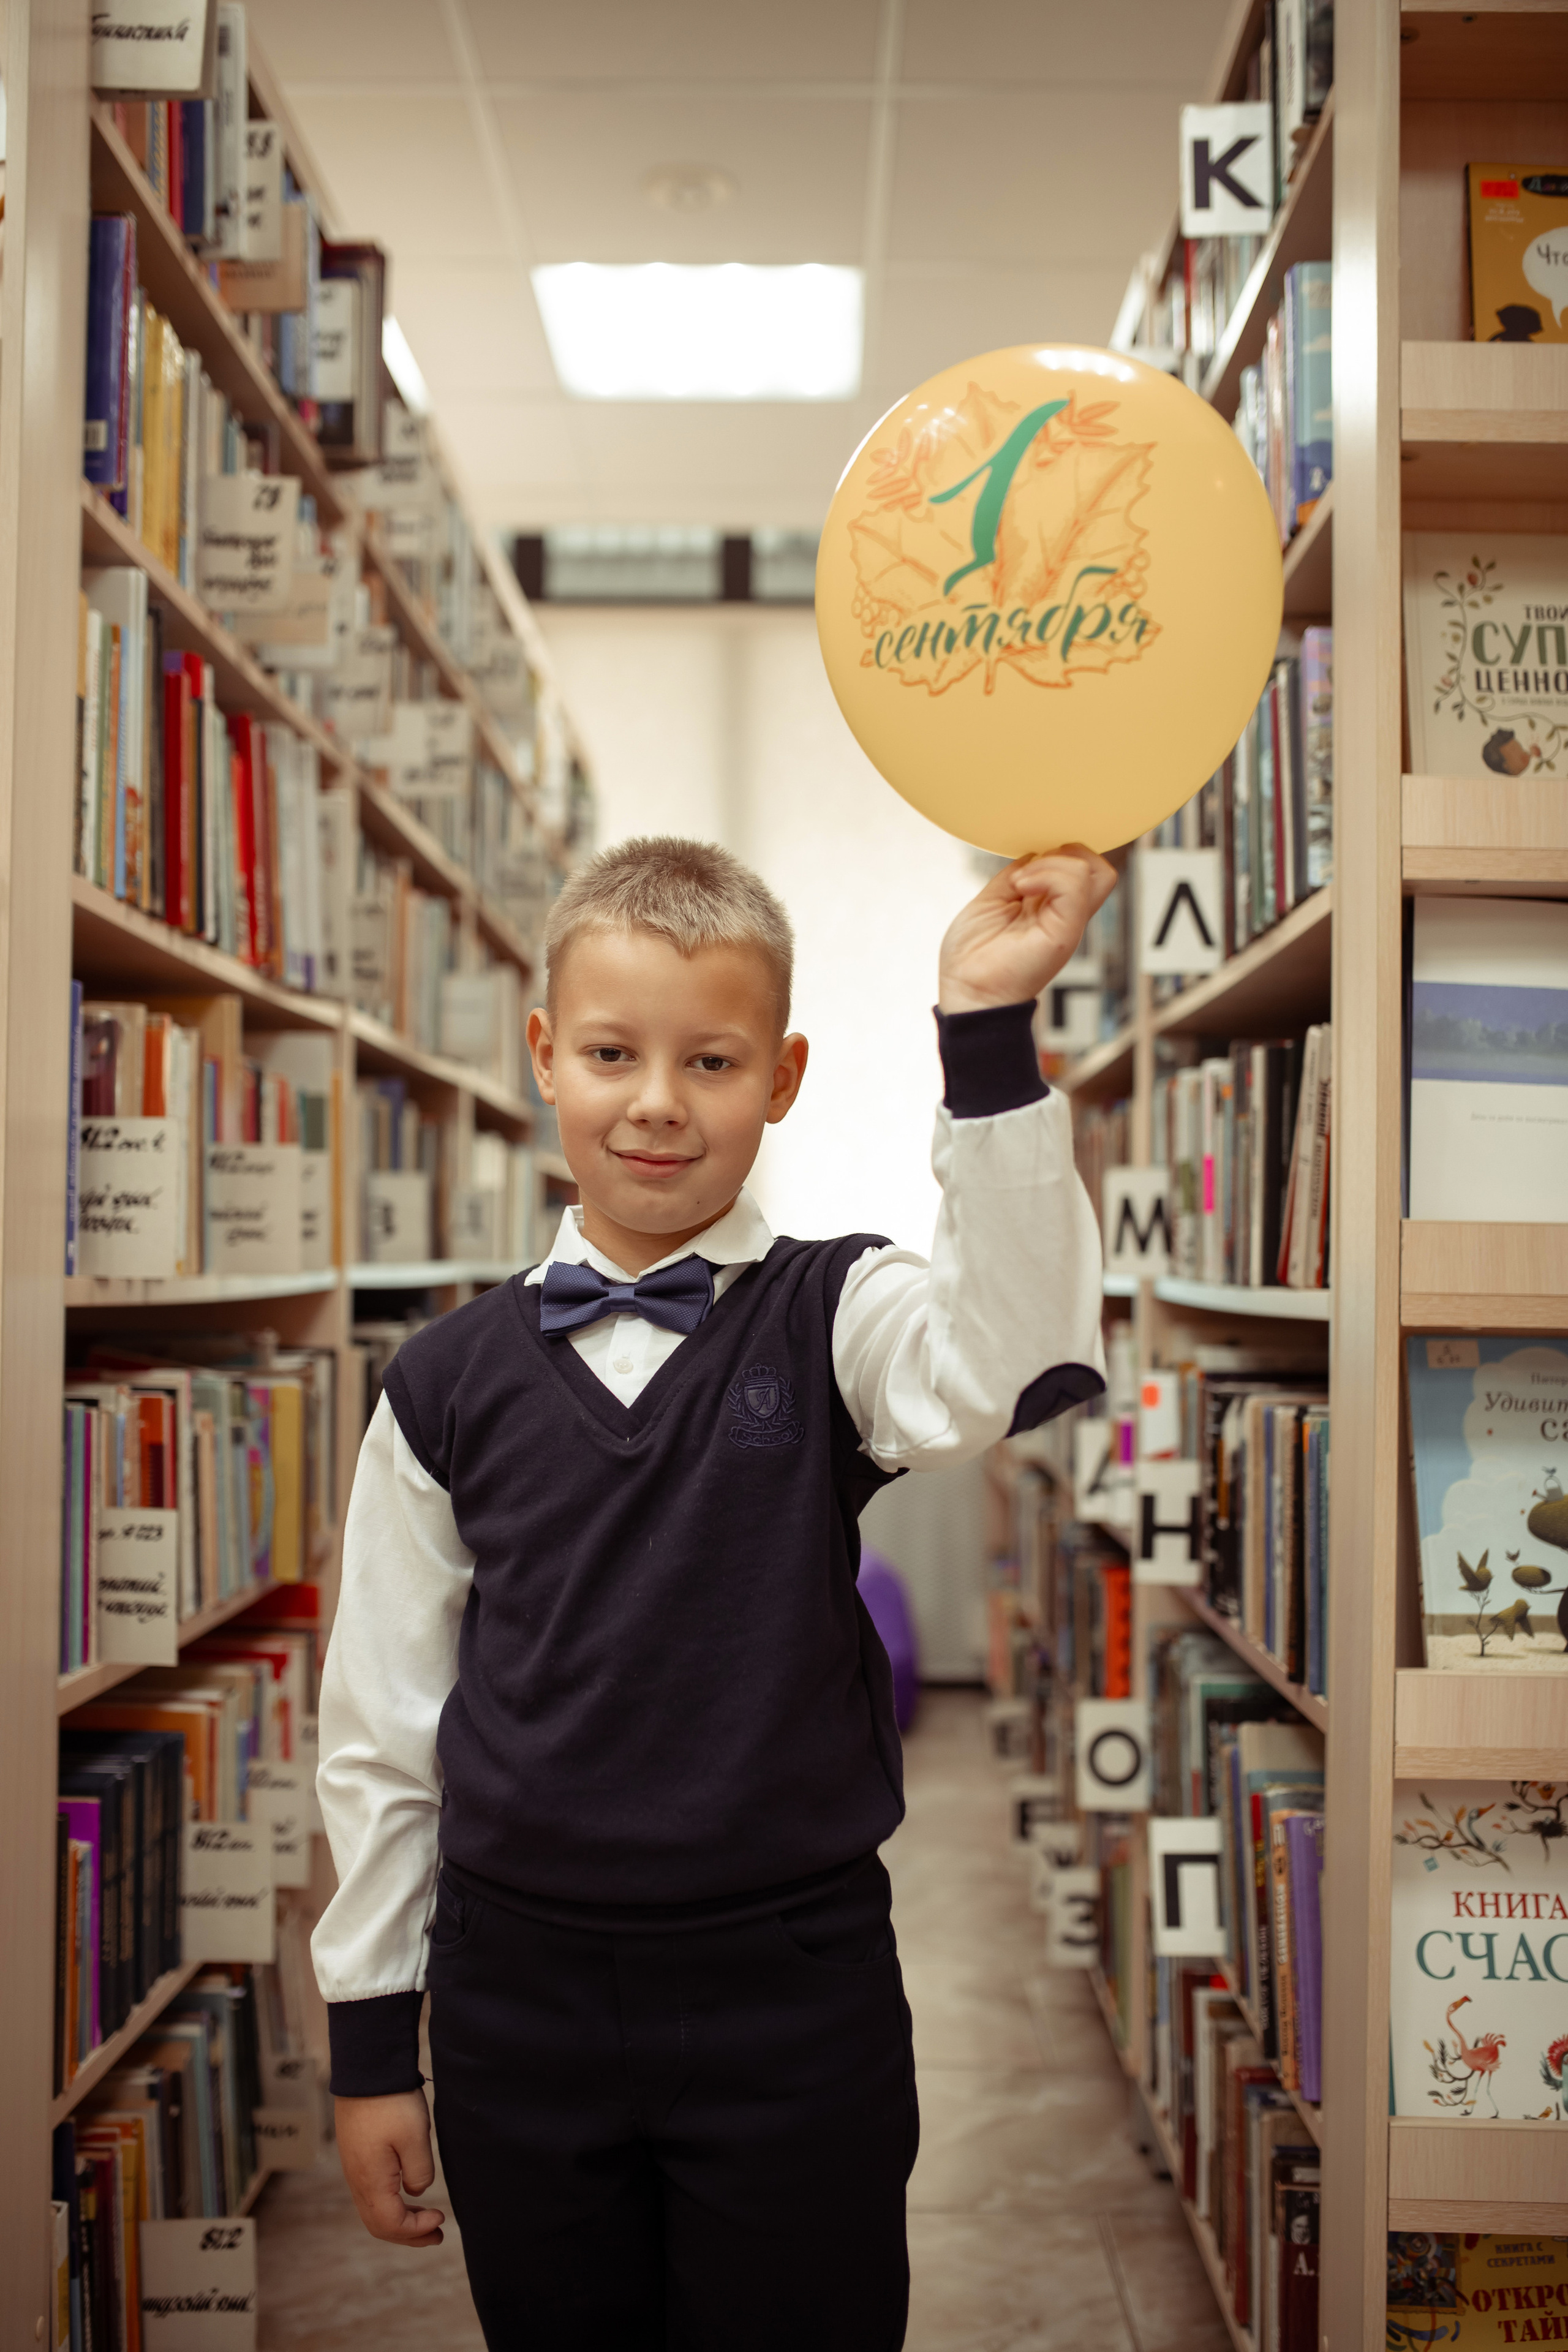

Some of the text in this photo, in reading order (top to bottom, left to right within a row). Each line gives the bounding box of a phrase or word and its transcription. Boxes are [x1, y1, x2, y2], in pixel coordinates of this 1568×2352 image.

[1193, 138, 1264, 209] К
[928, 399, 1071, 597] 1
[874, 565, 1148, 669] сентября
[1472, 620, 1567, 666] СУП
[1115, 1197, 1173, 1254] М
[742, 1429, 793, 1444] School
[1142, 1494, 1202, 1560] Н
[1088, 1730, 1142, 1787] О
[1452, 1891, 1568, 1920] КНИГА
[1415, 1930, 1568, 1984] СЧАС
[1487, 2255, 1555, 2267] СЕКРЕТАМИ
[1495, 2242, 1534, 2255] КНИГА
